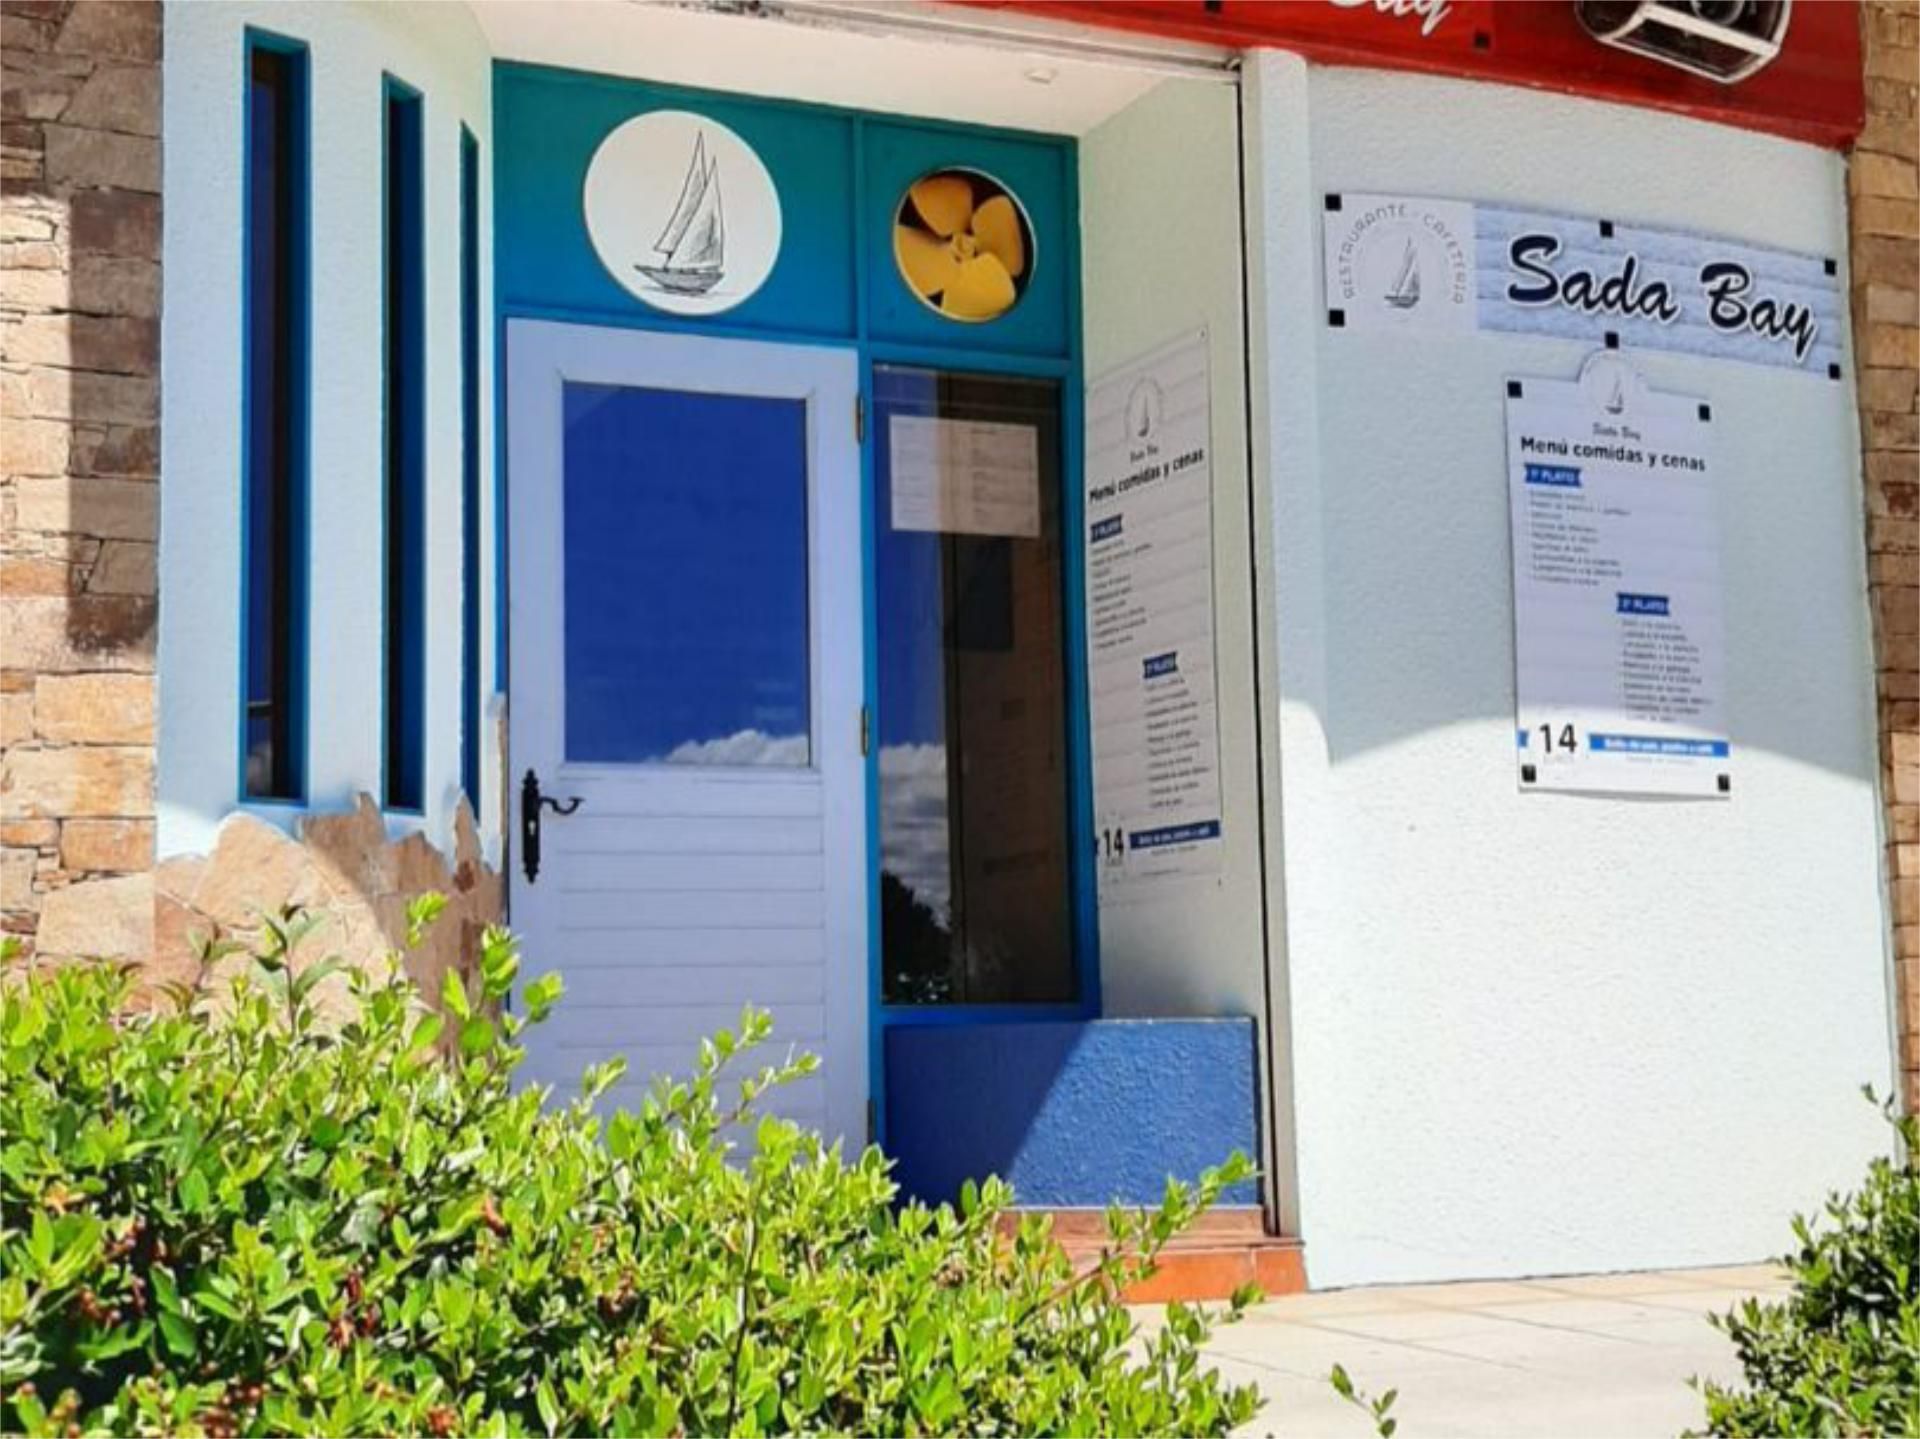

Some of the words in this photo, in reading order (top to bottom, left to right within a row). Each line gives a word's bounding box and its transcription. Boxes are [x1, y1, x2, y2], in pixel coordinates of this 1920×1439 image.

[1508, 236, 1678, 320] Sada
[1701, 263, 1817, 356] Bay
[1118, 464, 1160, 492] comidas
[1172, 448, 1204, 472] cenas
[1520, 435, 1568, 456] Menú
[1573, 443, 1644, 463] comidas
[1648, 451, 1659, 467] y
[1661, 452, 1706, 472] cenas
[1539, 723, 1577, 754] 14
[1102, 825, 1125, 859] 14
